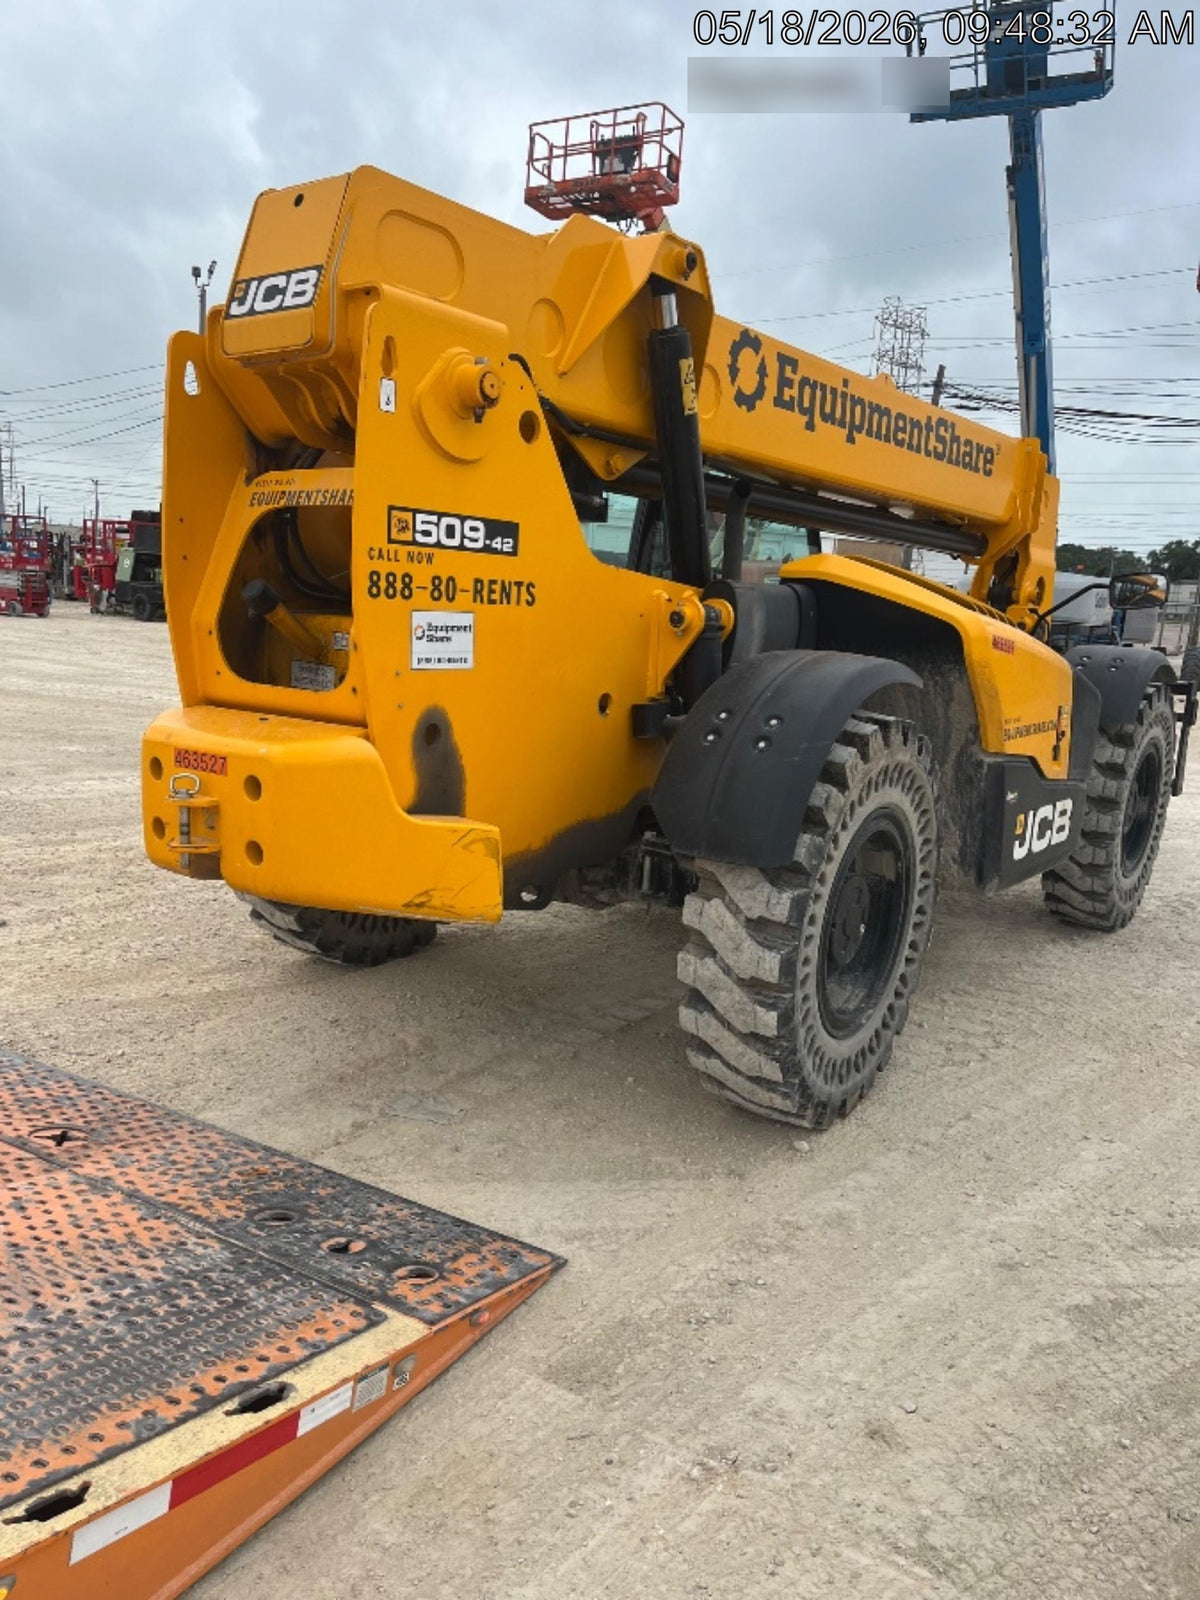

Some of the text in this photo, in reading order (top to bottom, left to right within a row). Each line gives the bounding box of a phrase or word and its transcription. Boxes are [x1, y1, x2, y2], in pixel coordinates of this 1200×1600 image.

[228, 269, 319, 315] JCB
[773, 351, 995, 477] EquipmentShare
[368, 547, 435, 565] CALL NOW
[367, 570, 536, 607] 888-80-RENTS
[174, 749, 227, 775] 463527
[1013, 798, 1073, 860] JCB
